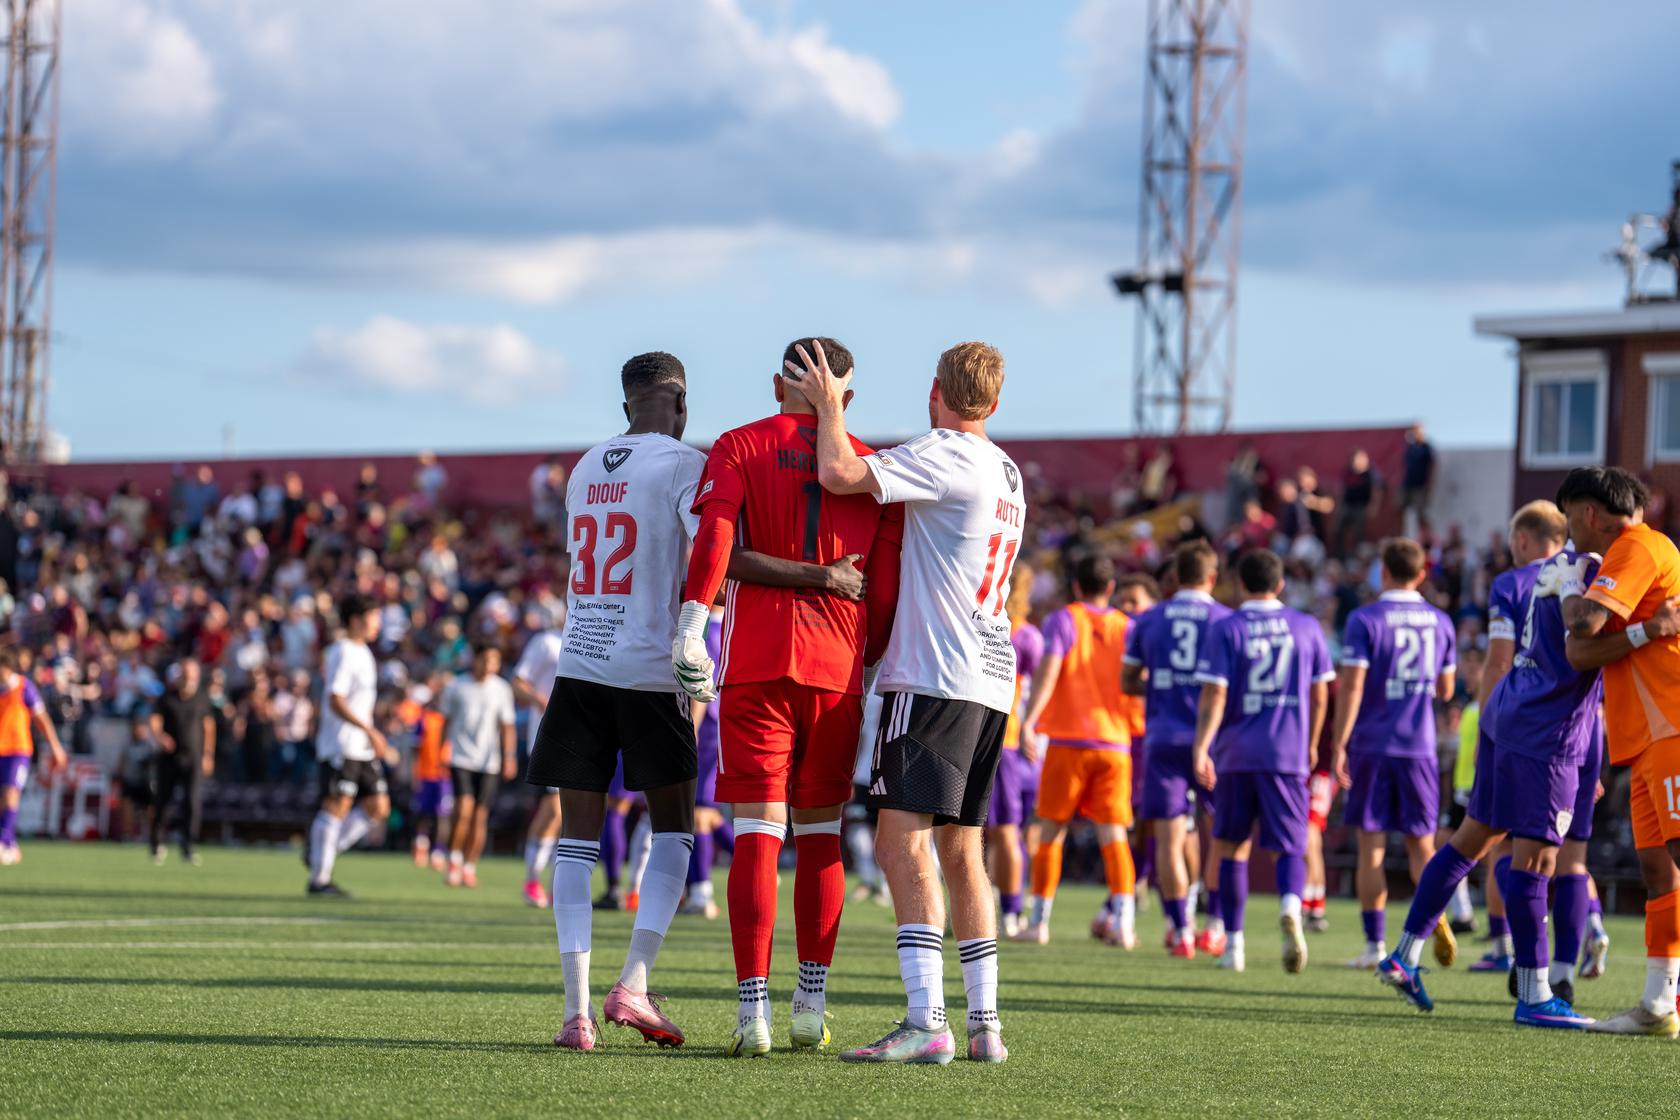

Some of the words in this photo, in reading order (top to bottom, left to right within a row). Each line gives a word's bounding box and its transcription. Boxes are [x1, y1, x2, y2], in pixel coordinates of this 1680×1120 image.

[587, 482, 628, 505] DIOUF
[996, 498, 1020, 528] RUTZ
[803, 481, 822, 560] 1
[571, 511, 637, 595] 32
[975, 533, 1017, 617] 11
[580, 623, 616, 632] SUPPOTIVE
[1169, 620, 1198, 671] 3
[584, 651, 611, 661] PEOPLE
[979, 652, 992, 660] AND
[985, 661, 995, 669] FOR
[1247, 634, 1294, 693] 27
[1394, 626, 1436, 681] 21
